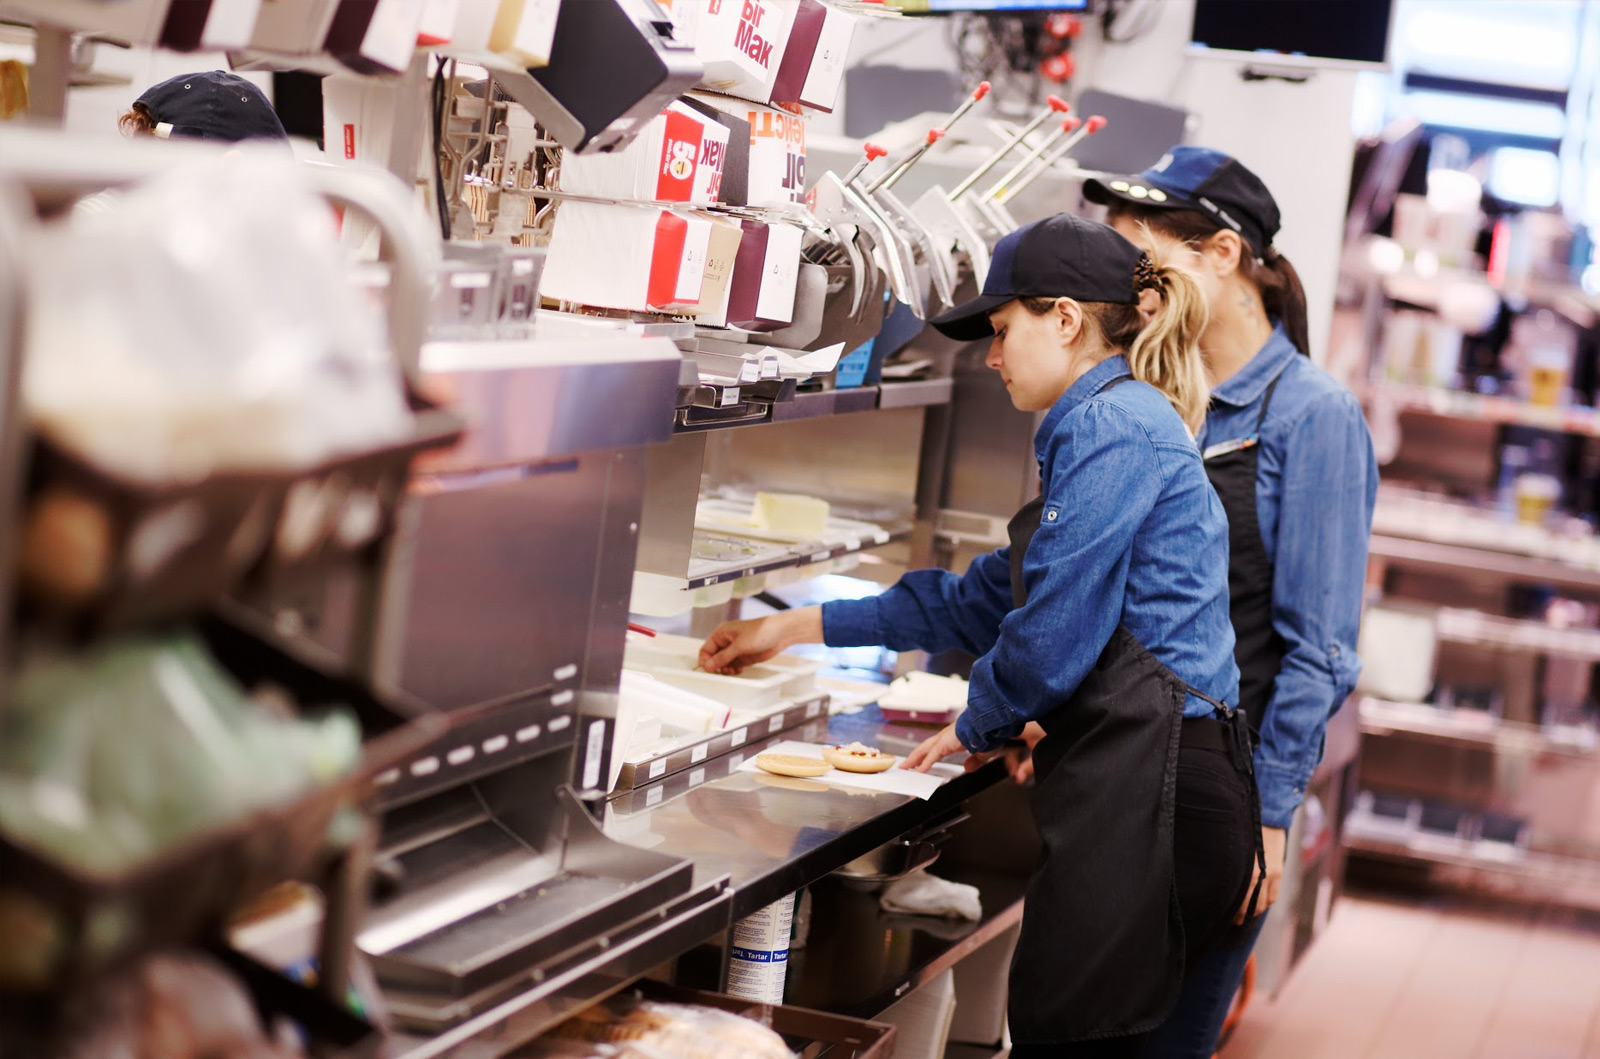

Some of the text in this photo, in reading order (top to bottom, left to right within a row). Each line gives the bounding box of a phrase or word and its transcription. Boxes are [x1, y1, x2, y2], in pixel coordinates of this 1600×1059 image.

[734, 18, 774, 70] Мак
[669, 140, 697, 180] 50
[747, 952, 768, 961] Tartar
